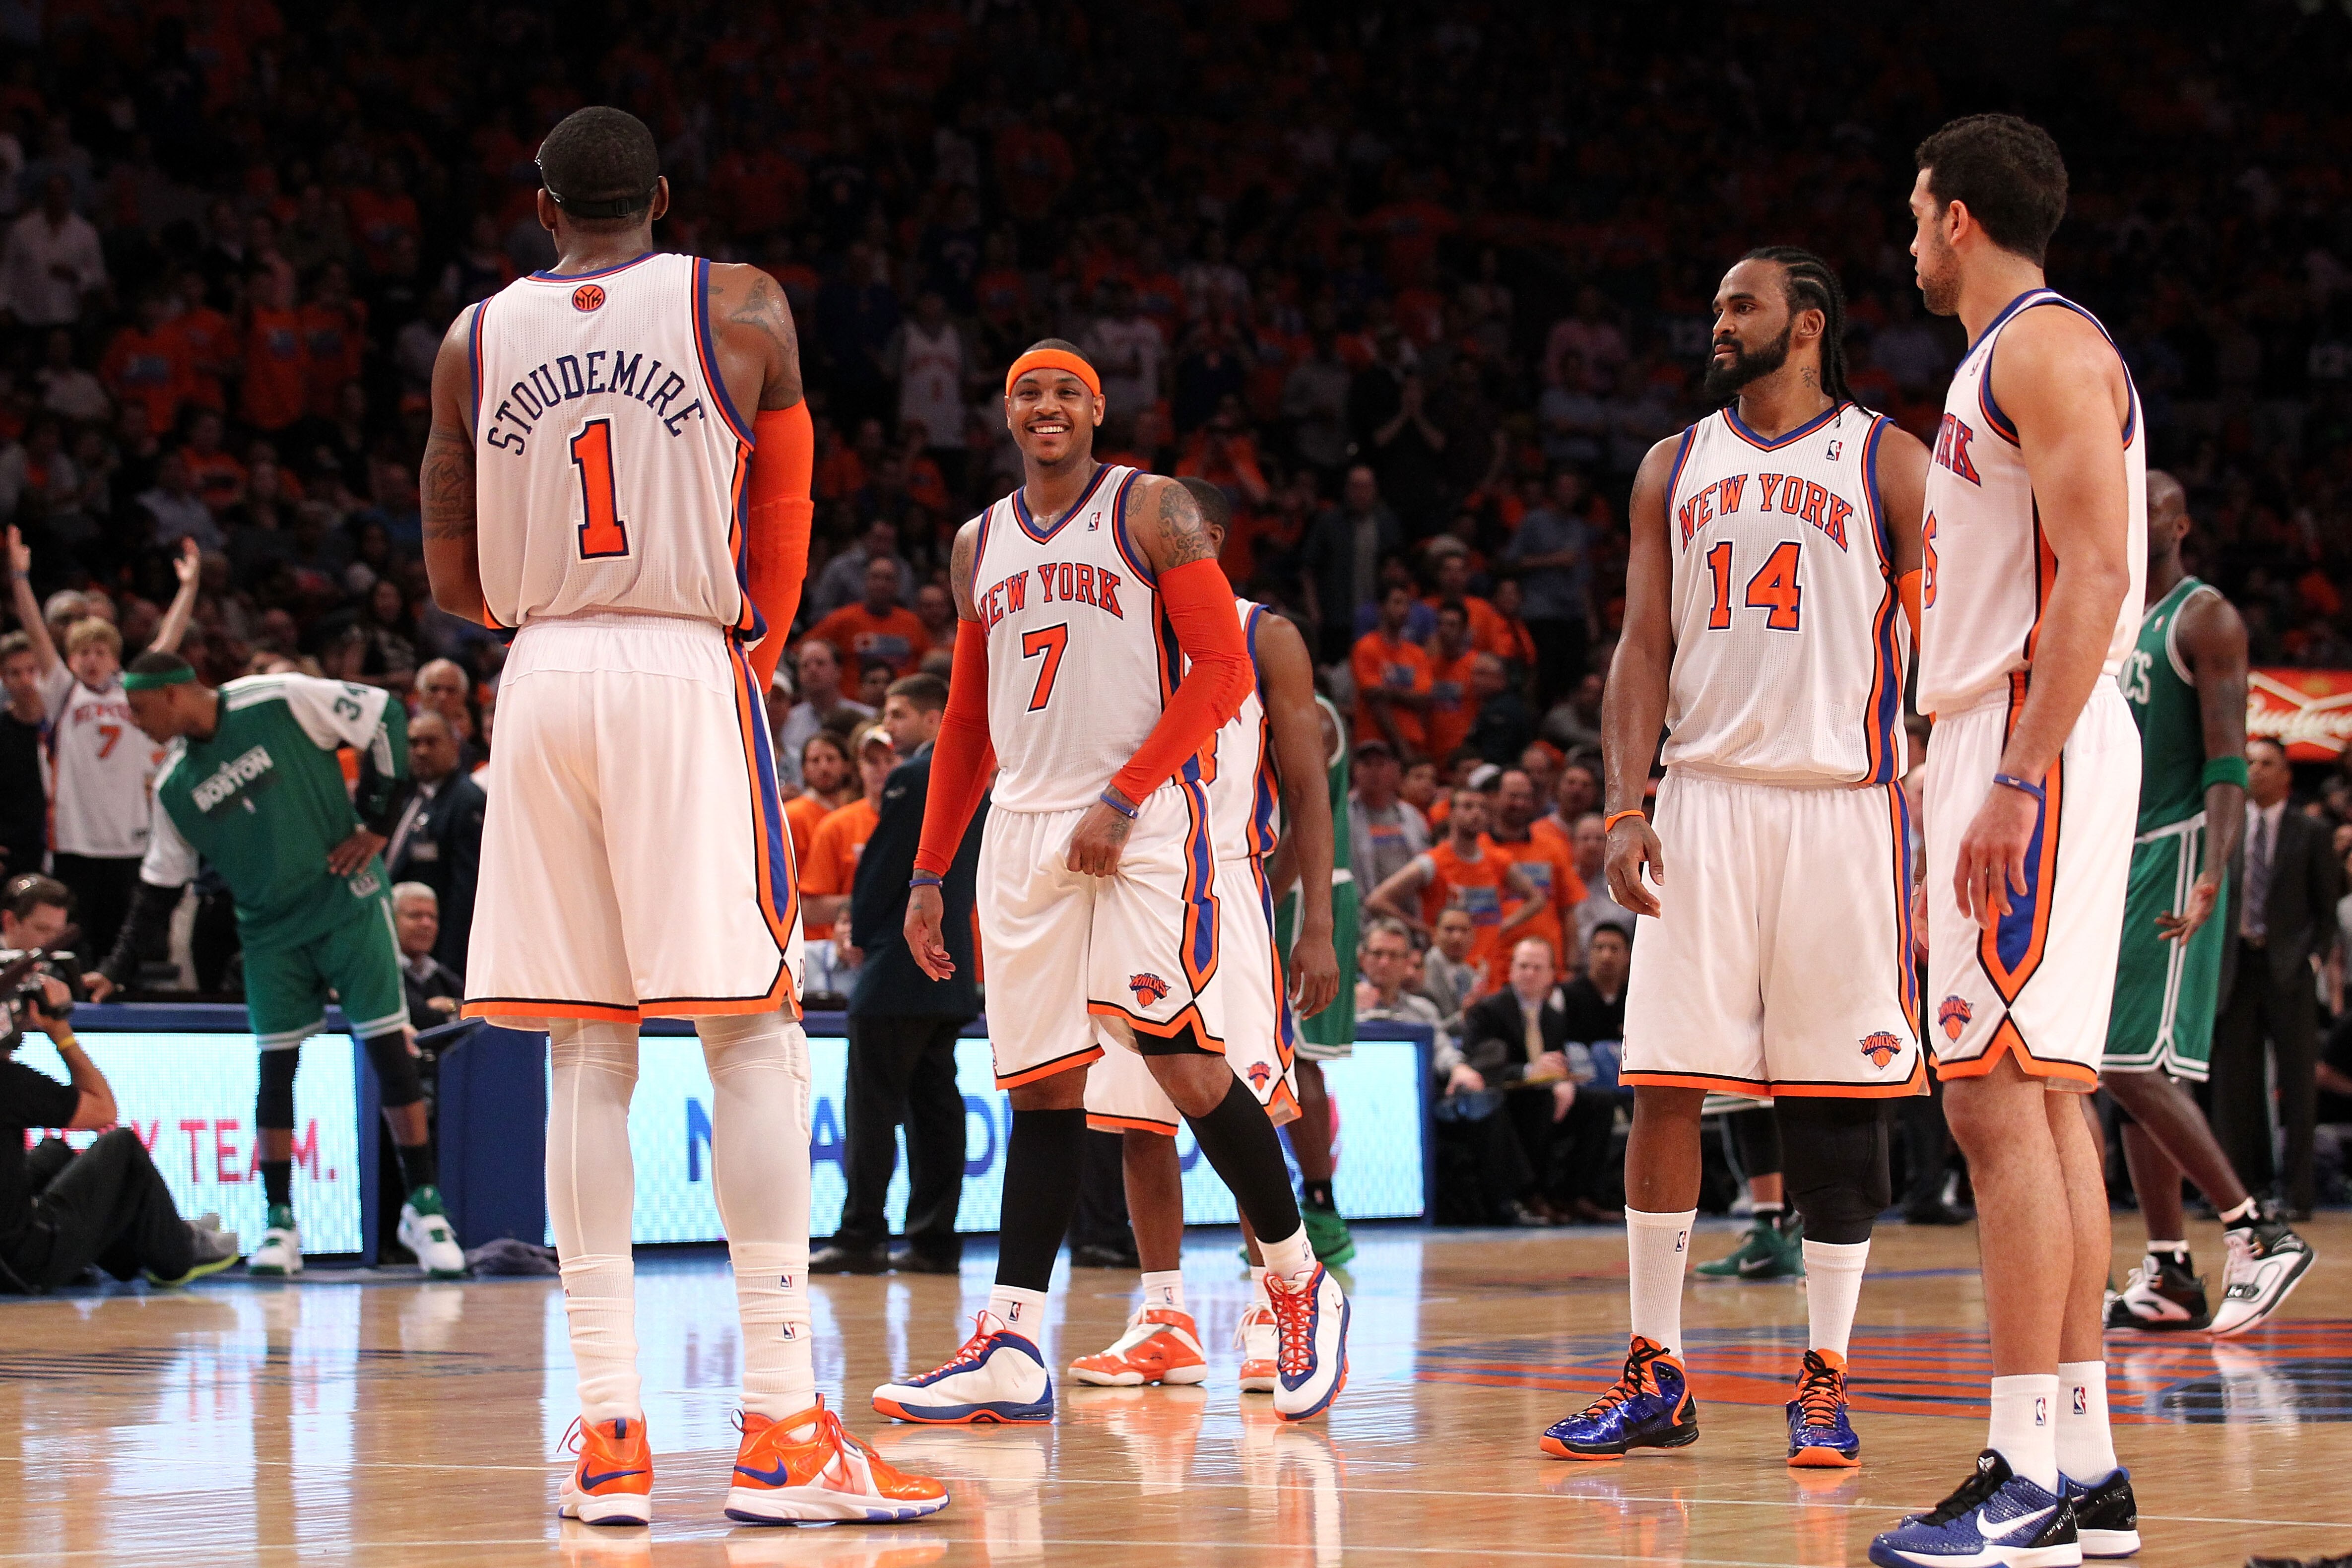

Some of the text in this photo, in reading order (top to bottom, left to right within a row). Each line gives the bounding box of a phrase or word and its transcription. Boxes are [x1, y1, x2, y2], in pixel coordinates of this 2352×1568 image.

[488, 350, 705, 456] STOUDEMIRE
[570, 417, 630, 561] 1
[1679, 473, 1853, 556] NEW YORK
[978, 562, 1124, 637] NEW YORK
[1705, 540, 1803, 632] 14
[1021, 622, 1069, 713] 7
[98, 724, 121, 759] 7
[192, 745, 273, 813] BOSTON
[1129, 974, 1167, 997] KNICKS
[1861, 1034, 1901, 1052] KNICKS
